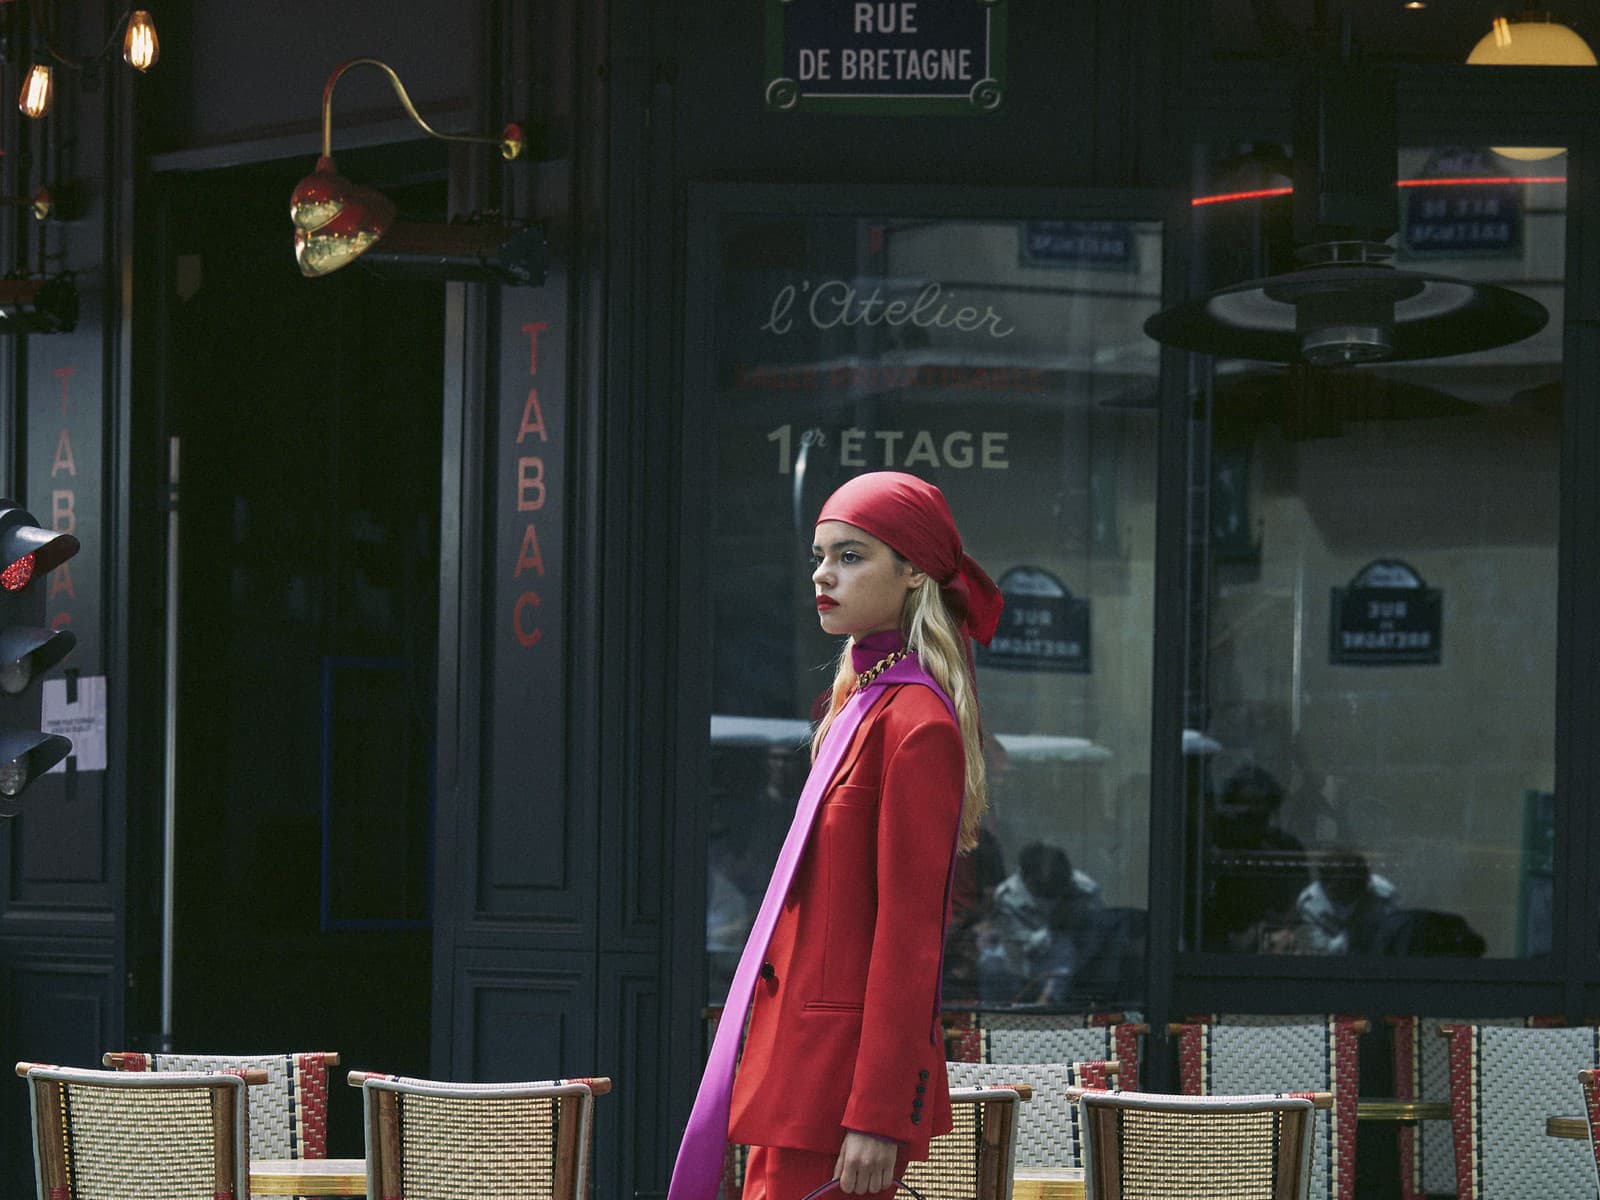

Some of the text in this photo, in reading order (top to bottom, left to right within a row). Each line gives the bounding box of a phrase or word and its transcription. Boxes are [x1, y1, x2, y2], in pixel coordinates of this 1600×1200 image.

[854, 2, 918, 33] RUE
[799, 48, 972, 81] DE BRETAGNE
[760, 280, 1016, 338] l'Atelier
[512, 321, 548, 648] TABAC
